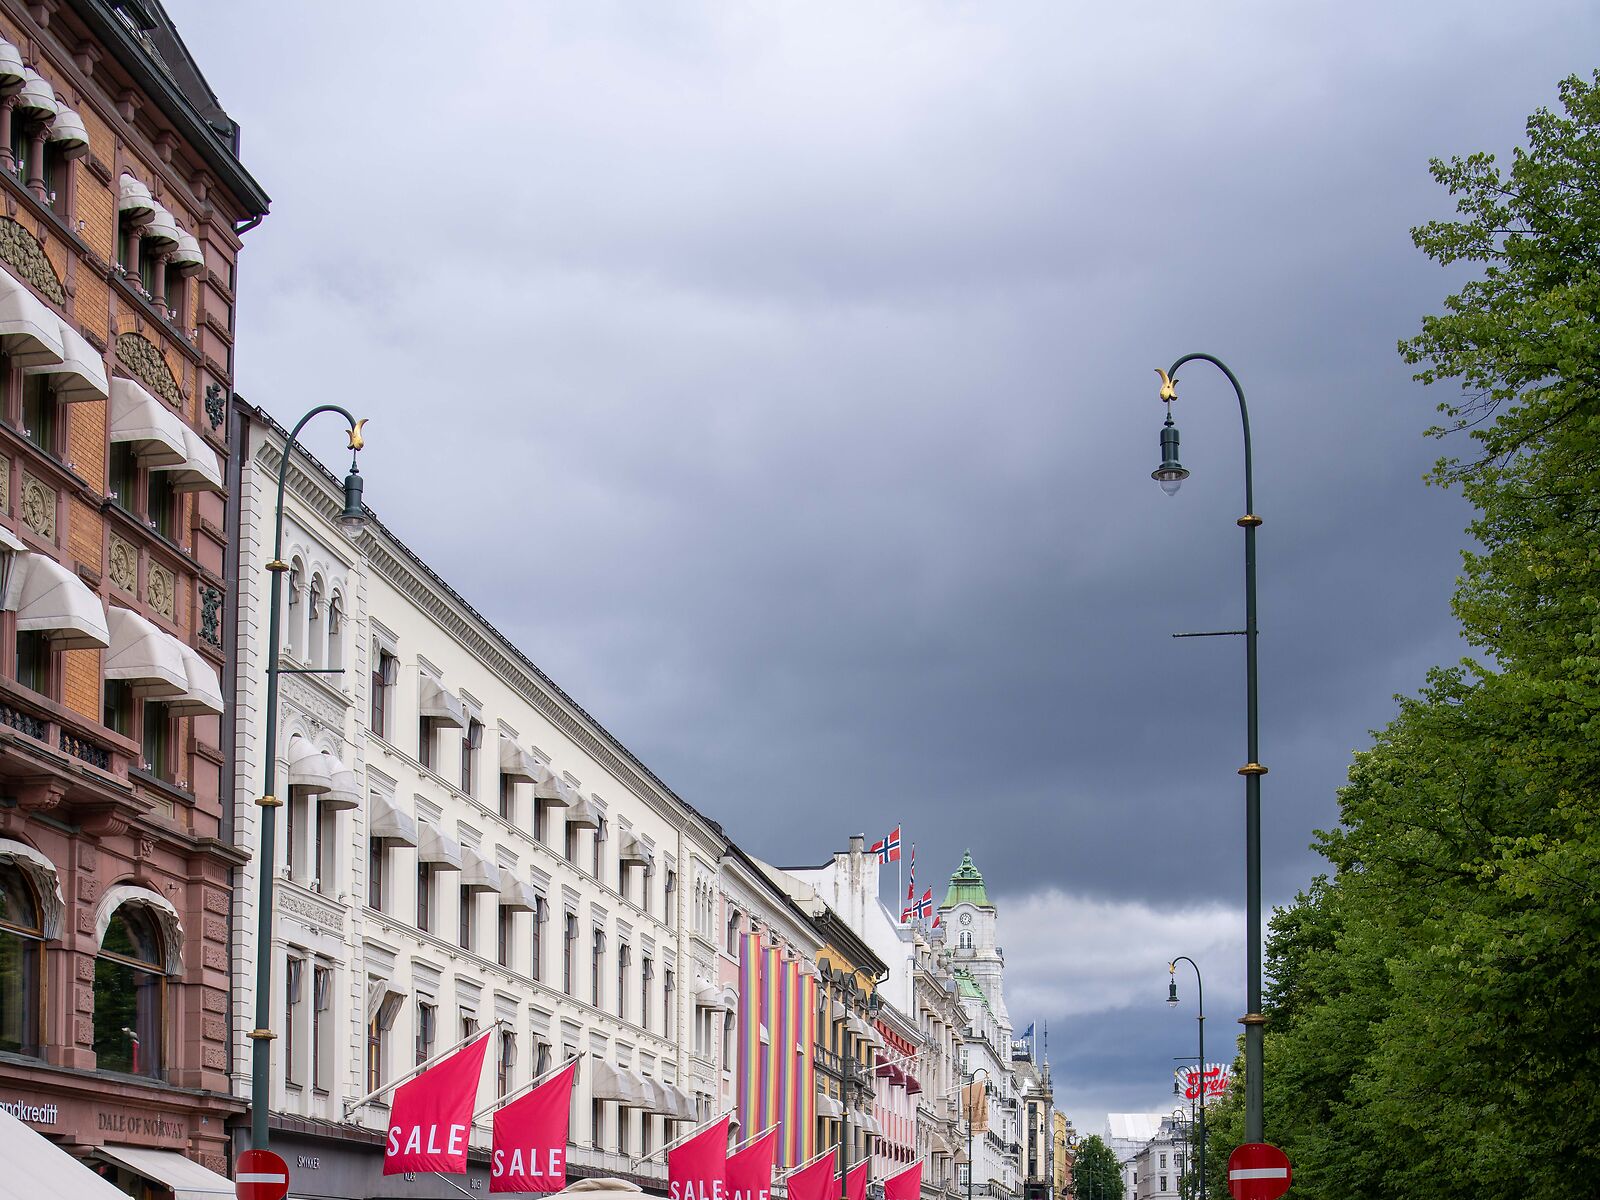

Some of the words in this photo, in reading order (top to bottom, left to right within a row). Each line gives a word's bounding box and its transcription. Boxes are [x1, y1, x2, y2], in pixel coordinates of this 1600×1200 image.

[1185, 1068, 1229, 1099] Frei
[99, 1113, 125, 1132] DALE
[128, 1118, 140, 1134] OF
[143, 1120, 184, 1139] NORWAY
[387, 1124, 466, 1157] SALE
[493, 1148, 562, 1177] SALE
[670, 1180, 723, 1200] SALE
